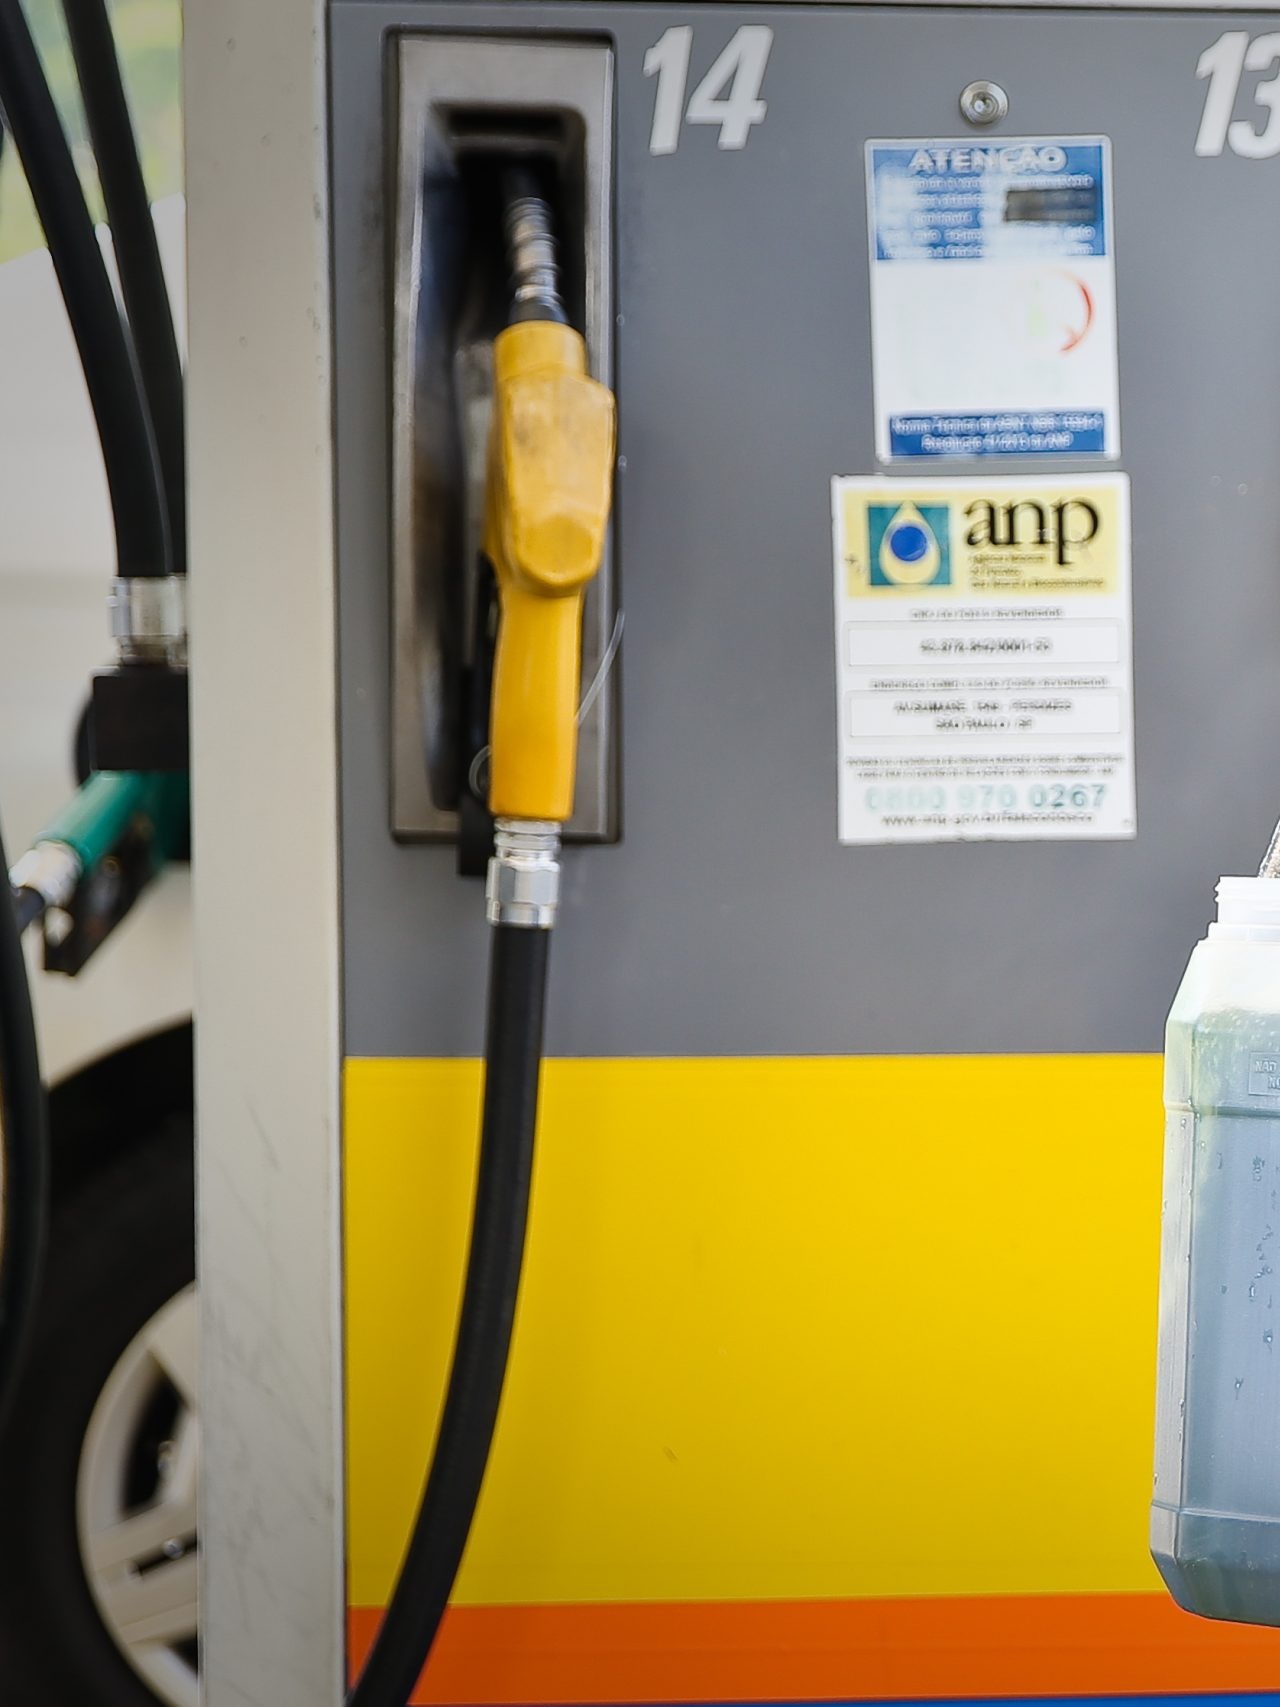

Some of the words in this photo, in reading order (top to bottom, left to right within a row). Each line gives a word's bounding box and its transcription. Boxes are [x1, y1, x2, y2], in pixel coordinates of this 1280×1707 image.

[643, 25, 774, 156] 14
[964, 498, 1099, 566] anp
[957, 784, 1017, 809] 970
[1028, 783, 1107, 808] 0267
